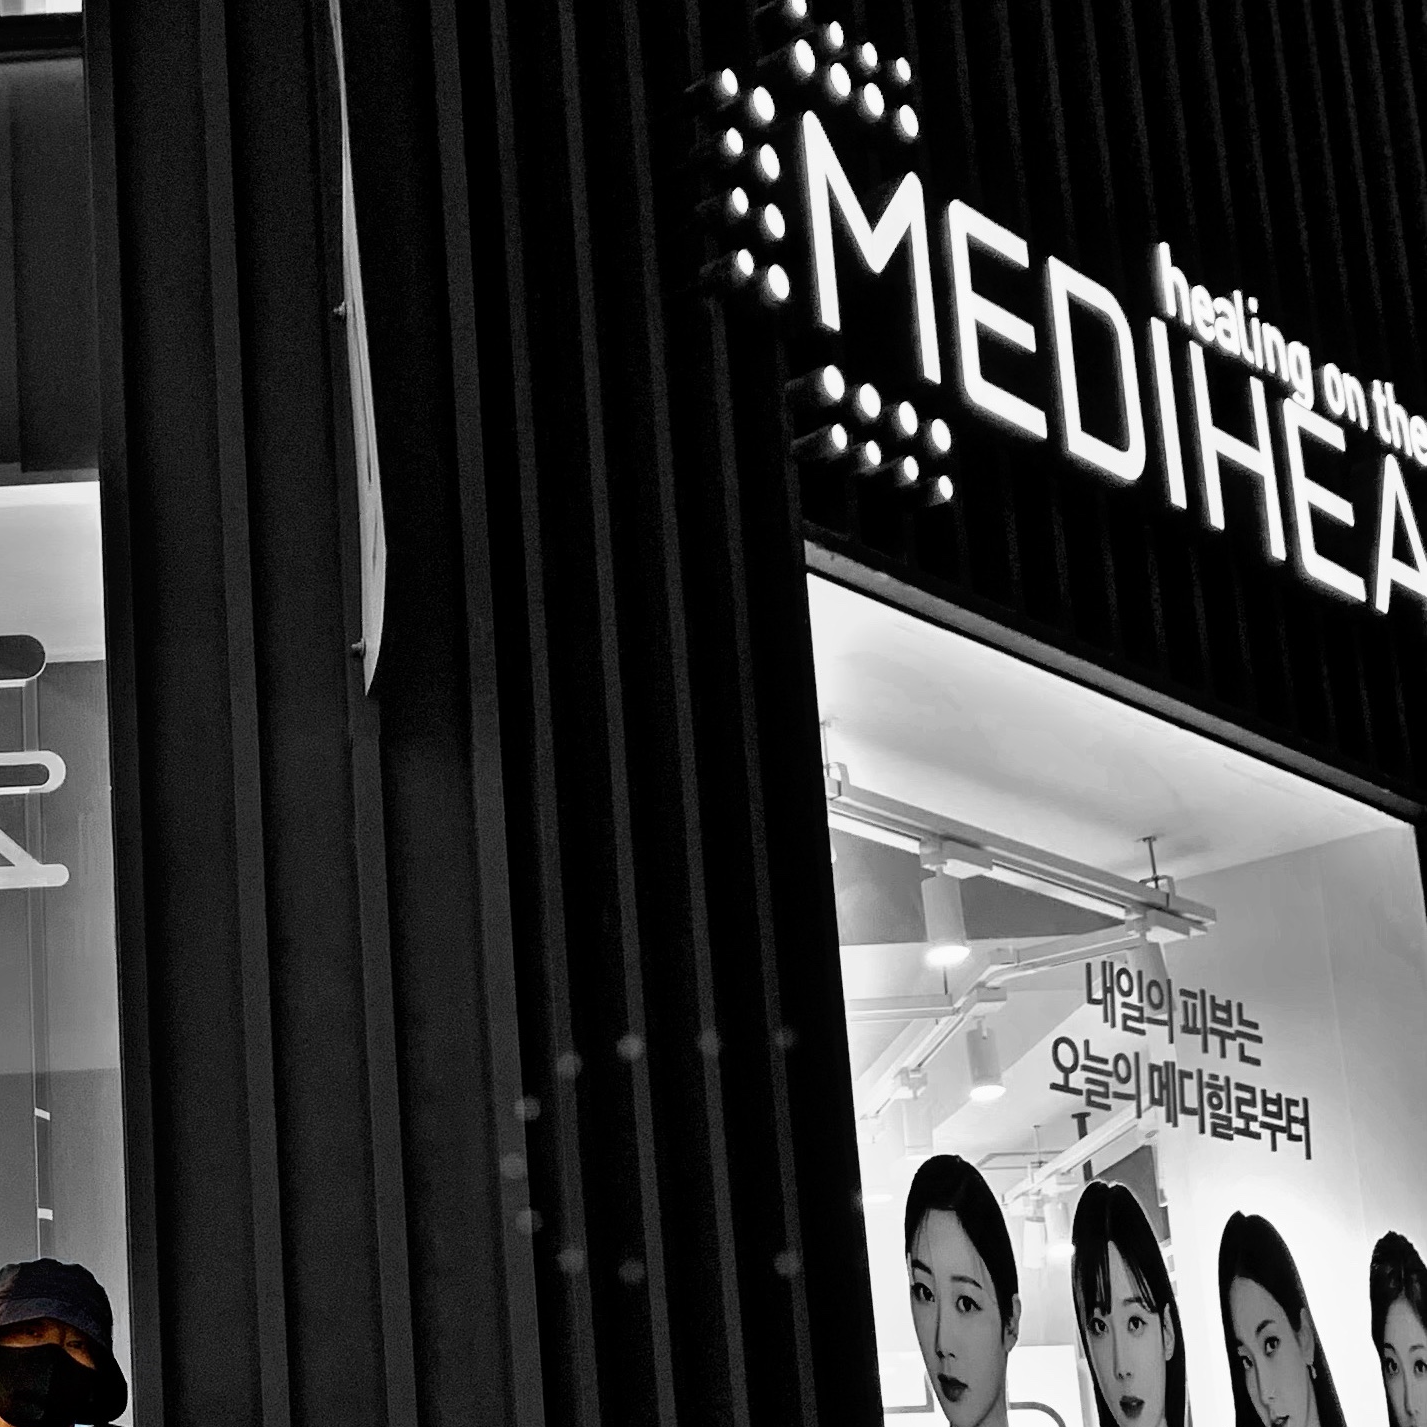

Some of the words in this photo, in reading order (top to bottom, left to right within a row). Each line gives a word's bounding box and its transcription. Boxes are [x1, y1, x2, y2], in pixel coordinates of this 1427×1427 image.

[1158, 241, 1314, 412] healing
[1323, 362, 1369, 431] on
[1372, 379, 1427, 467] the
[1085, 959, 1175, 1045] 내일의
[1179, 987, 1264, 1067] 피부는
[1049, 1036, 1143, 1120] 오늘의
[1148, 1060, 1312, 1160] 메디힐로부터
